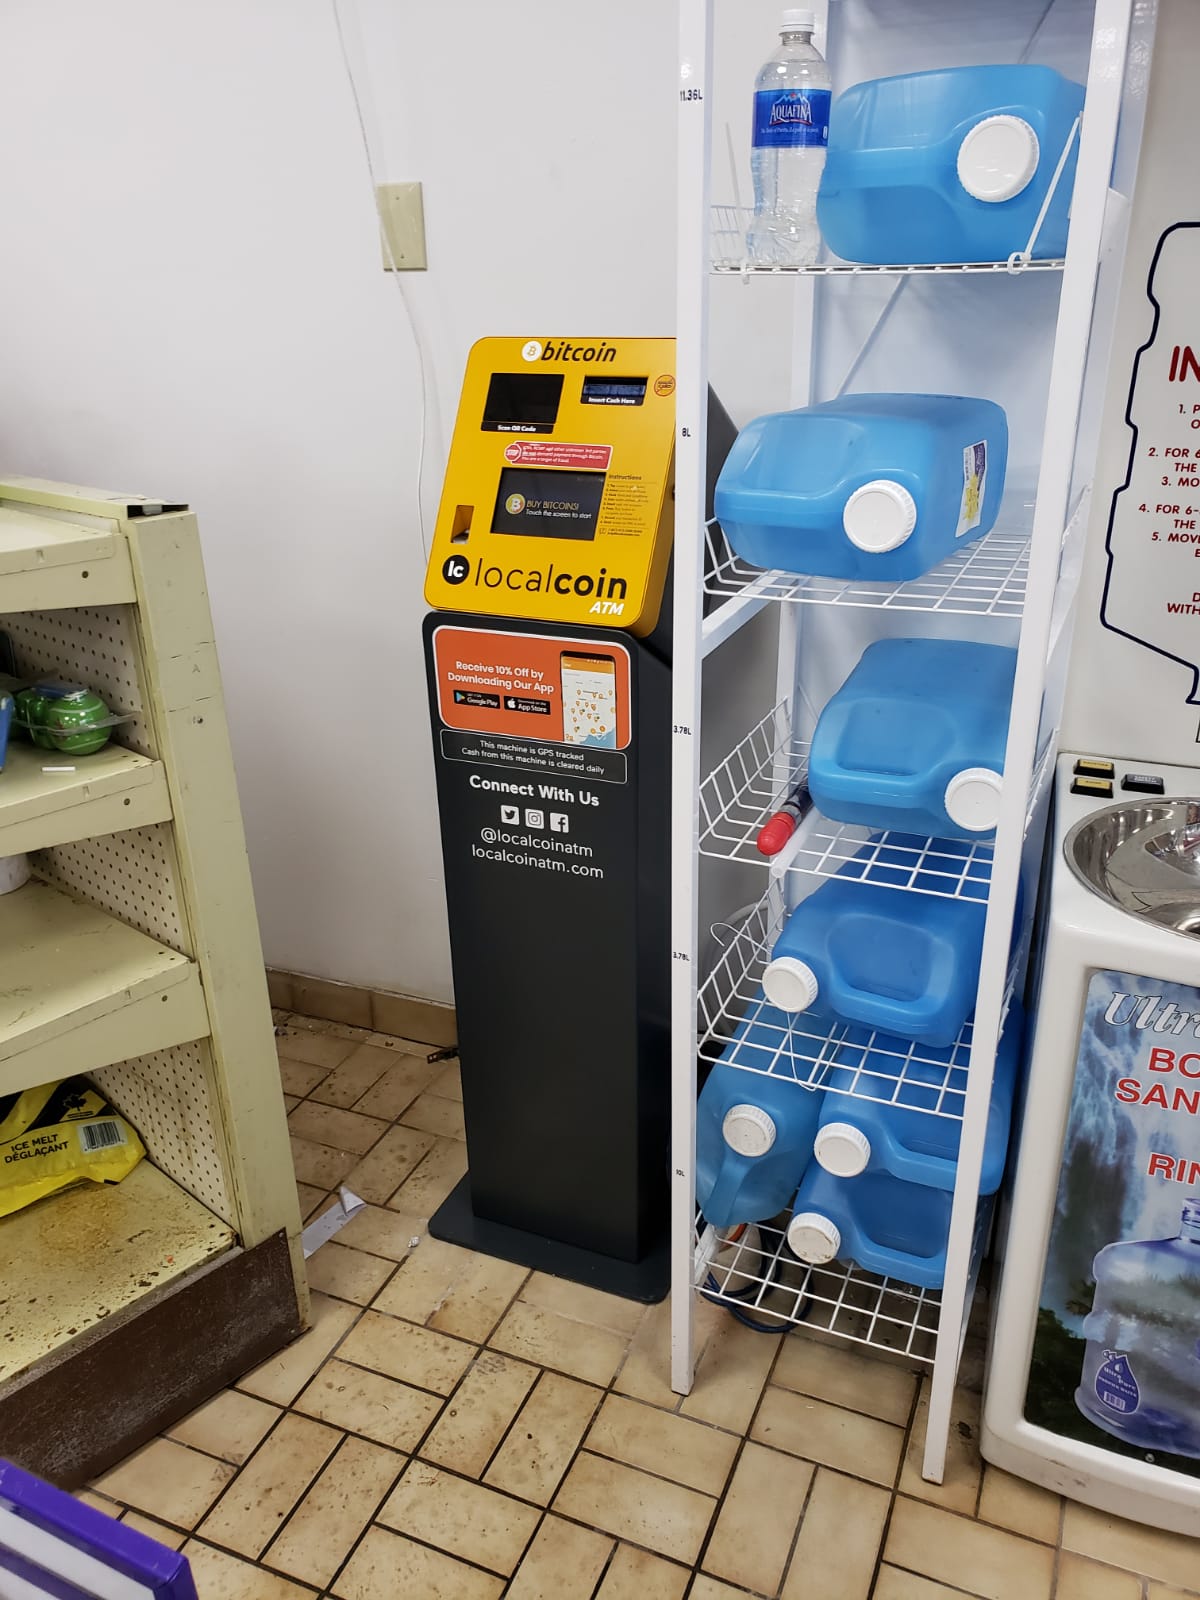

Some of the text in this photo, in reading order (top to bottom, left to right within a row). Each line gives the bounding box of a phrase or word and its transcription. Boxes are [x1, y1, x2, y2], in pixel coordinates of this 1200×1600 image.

[680, 89, 703, 102] 11.36L
[770, 104, 812, 124] AQUAFINA
[541, 341, 616, 362] bitcoin
[682, 427, 691, 437] 8L
[1148, 447, 1158, 456] 2.
[1164, 448, 1190, 458] FOR
[1174, 463, 1198, 472] THE
[1162, 476, 1171, 486] 3.
[1138, 504, 1200, 515] 4. FOR 6-
[1174, 519, 1196, 529] THE
[1152, 532, 1162, 541] 5.
[475, 558, 627, 600] localcoin
[590, 601, 625, 616] ATM
[456, 661, 544, 681] Receive 10% Off by
[448, 672, 554, 694] Downloading Our App
[467, 697, 498, 708] Google Play
[674, 725, 691, 735] 3.78L
[480, 740, 495, 749] This
[497, 743, 527, 753] machine
[538, 748, 554, 757] GPS
[556, 751, 584, 761] tracked
[462, 748, 480, 757] Cash
[481, 750, 499, 759] from
[500, 752, 514, 761] this
[516, 755, 547, 766] machine
[556, 760, 584, 771] cleared
[586, 764, 605, 775] daily
[469, 775, 600, 807] Connect With Us
[480, 827, 593, 857] @localcoinatm
[472, 844, 604, 879] localcoinatm.com
[1115, 1078, 1200, 1116] SAN
[4, 1141, 69, 1163] DÉGLAÇANT
[11, 1134, 59, 1152] ICE MELT
